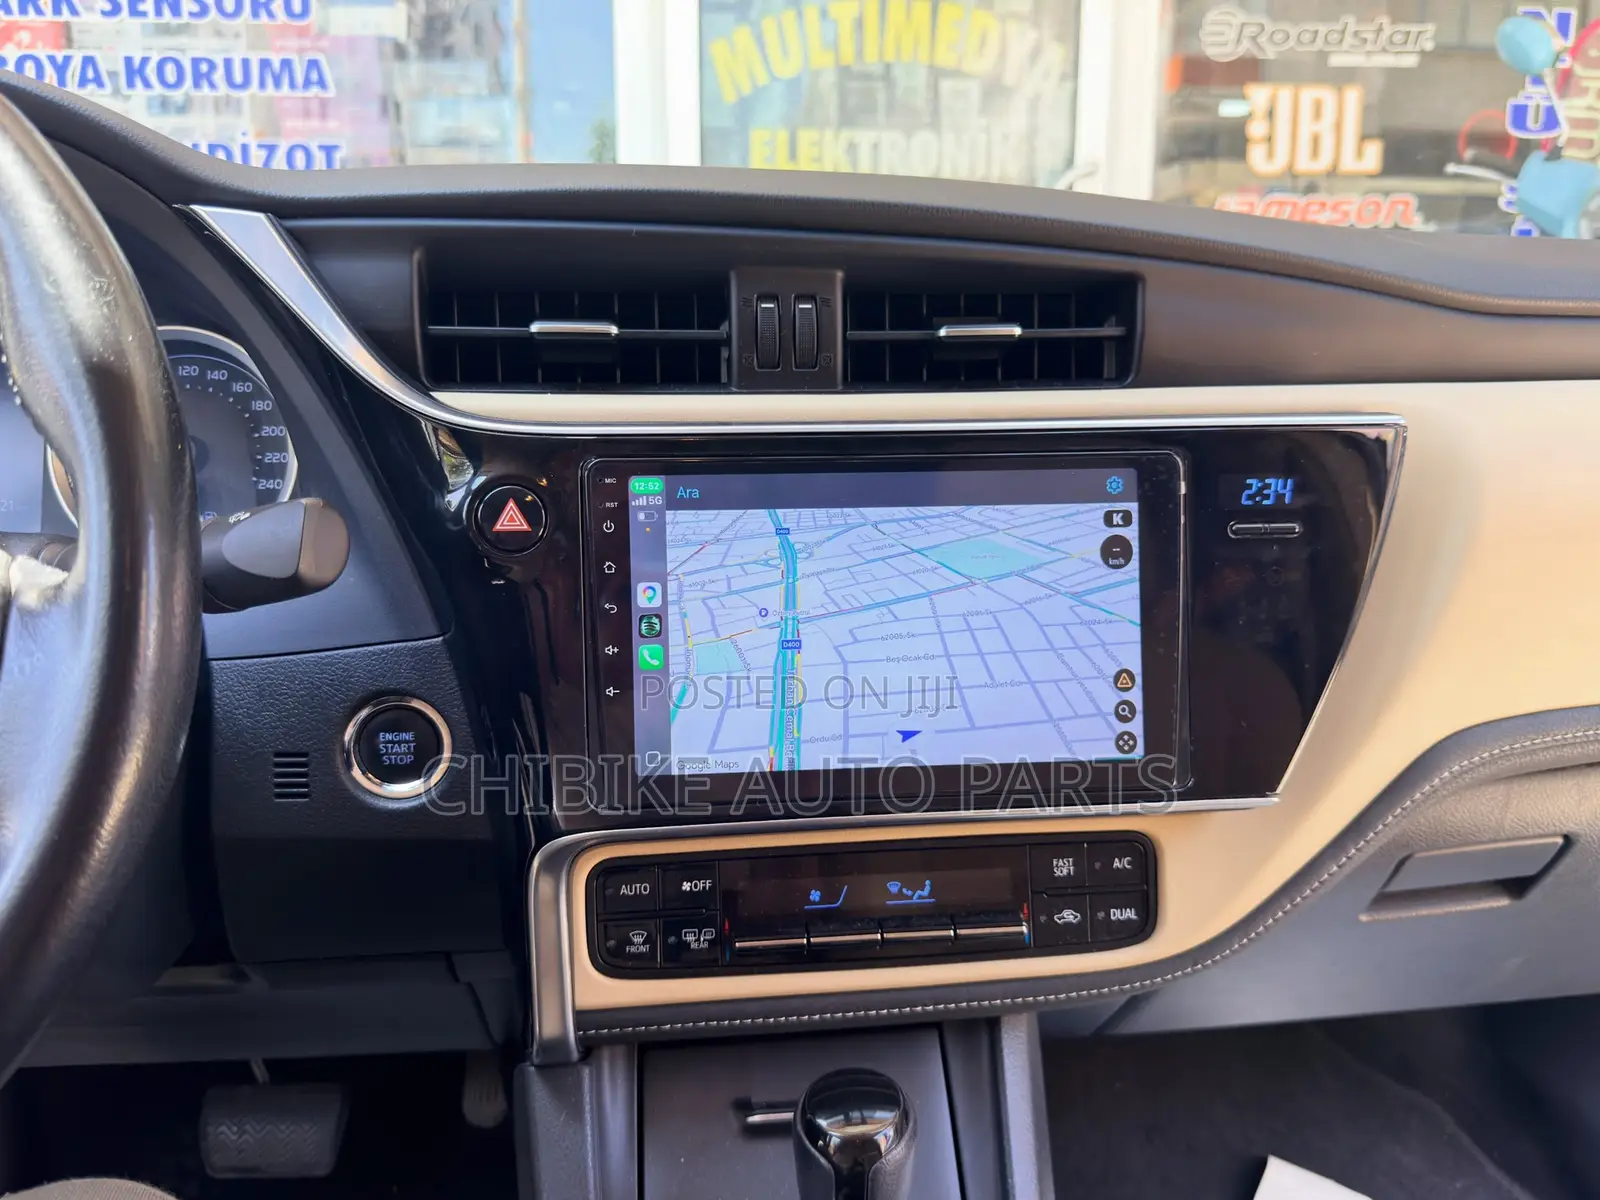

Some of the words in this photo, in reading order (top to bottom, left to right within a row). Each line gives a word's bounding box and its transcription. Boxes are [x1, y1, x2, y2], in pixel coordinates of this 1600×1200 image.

[124, 55, 328, 92] KORUMA
[1245, 83, 1384, 175] JBL
[178, 364, 200, 377] 120
[206, 369, 228, 382] 140
[232, 382, 253, 393] 160
[251, 400, 272, 412] 180
[260, 426, 286, 437] 200
[264, 452, 289, 464] 220
[257, 478, 283, 490] 240
[634, 481, 660, 491] 12:52
[677, 486, 700, 499] Ara
[1240, 478, 1295, 505] 2:34
[648, 495, 662, 505] 5G
[1112, 512, 1124, 526] K
[1108, 557, 1126, 566] km/h
[782, 641, 800, 649] D400
[379, 732, 416, 741] ENGINE
[379, 743, 416, 754] START
[382, 755, 415, 765] STOP
[676, 760, 711, 772] Google
[714, 759, 740, 770] Maps
[1052, 858, 1073, 868] FAST
[1112, 857, 1132, 869] A/C
[1053, 867, 1074, 877] SOFT
[620, 883, 650, 896] AUTO
[691, 880, 712, 892] OFF
[1110, 908, 1138, 920] DUAL
[625, 944, 650, 954] FRONT
[690, 940, 709, 950] REAR
